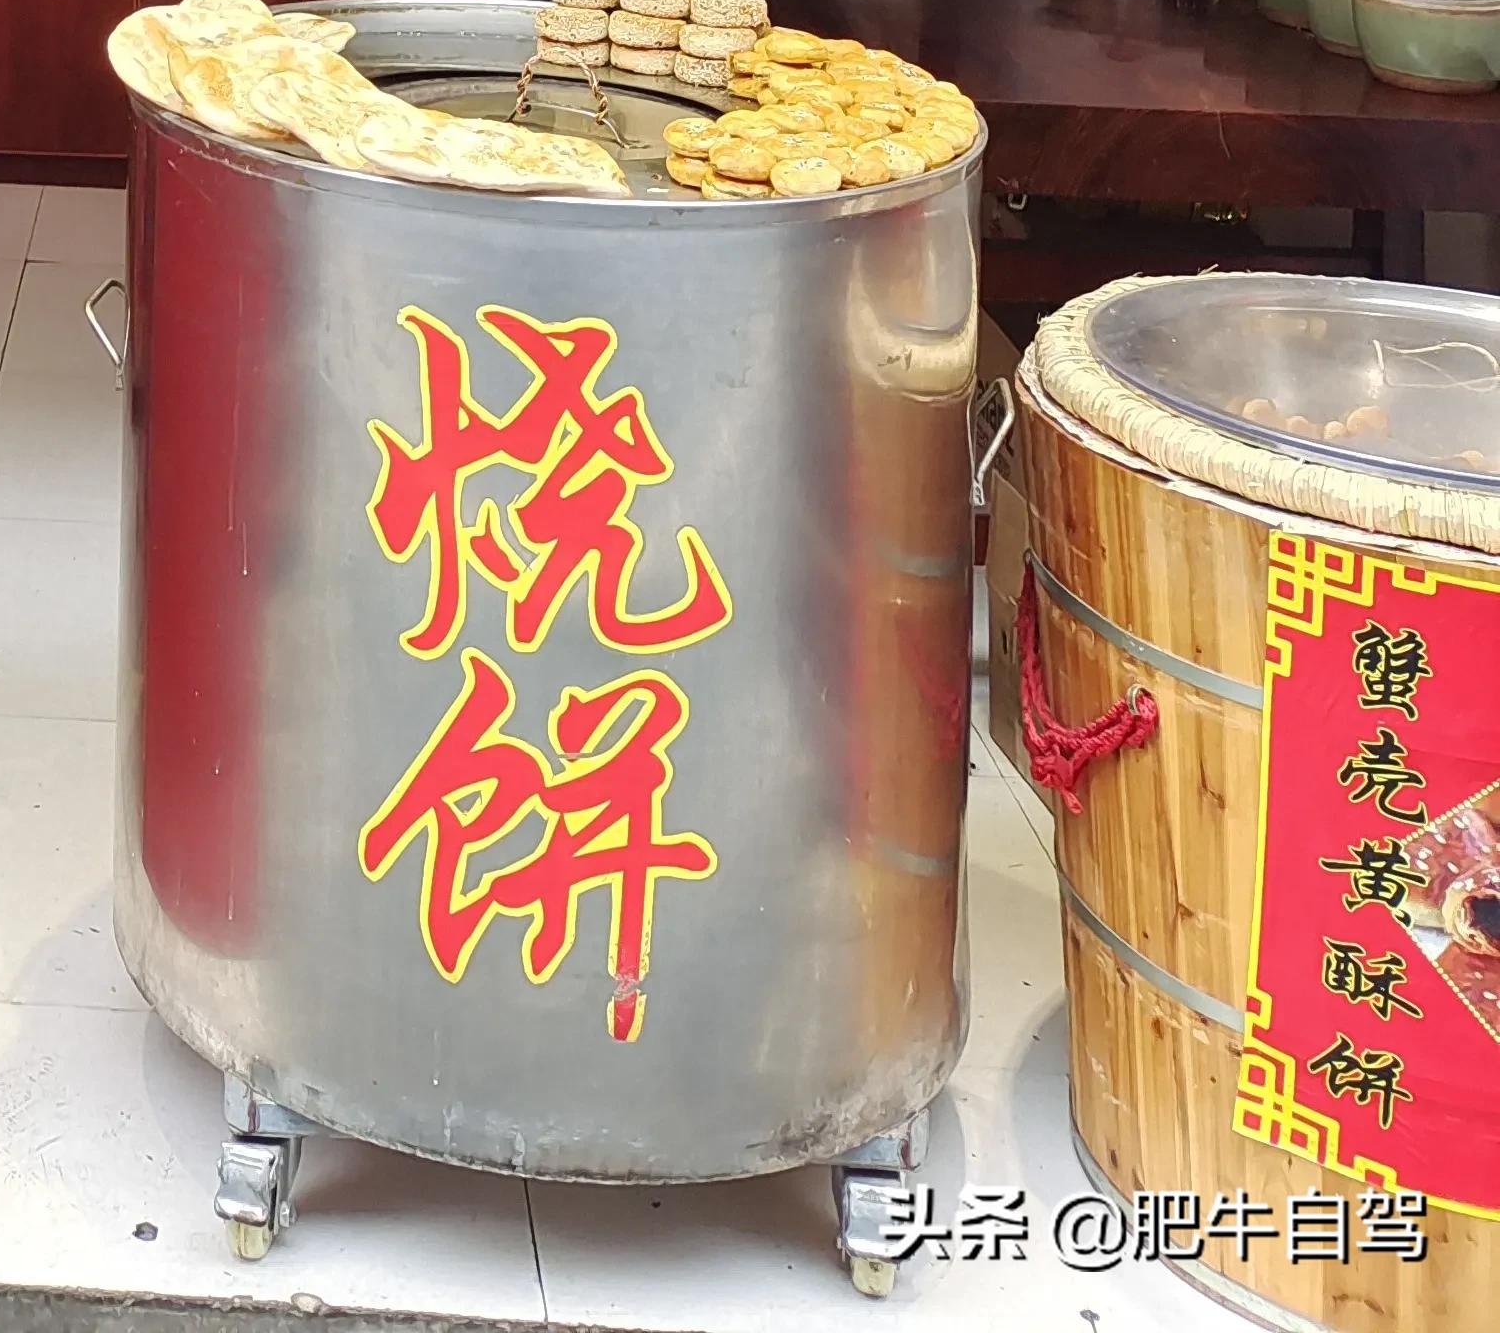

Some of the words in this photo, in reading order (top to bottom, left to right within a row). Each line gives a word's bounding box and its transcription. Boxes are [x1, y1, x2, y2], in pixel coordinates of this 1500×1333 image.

[358, 304, 733, 1044] 烧饼
[1308, 619, 1433, 1130] 蟹壳黄酥饼
